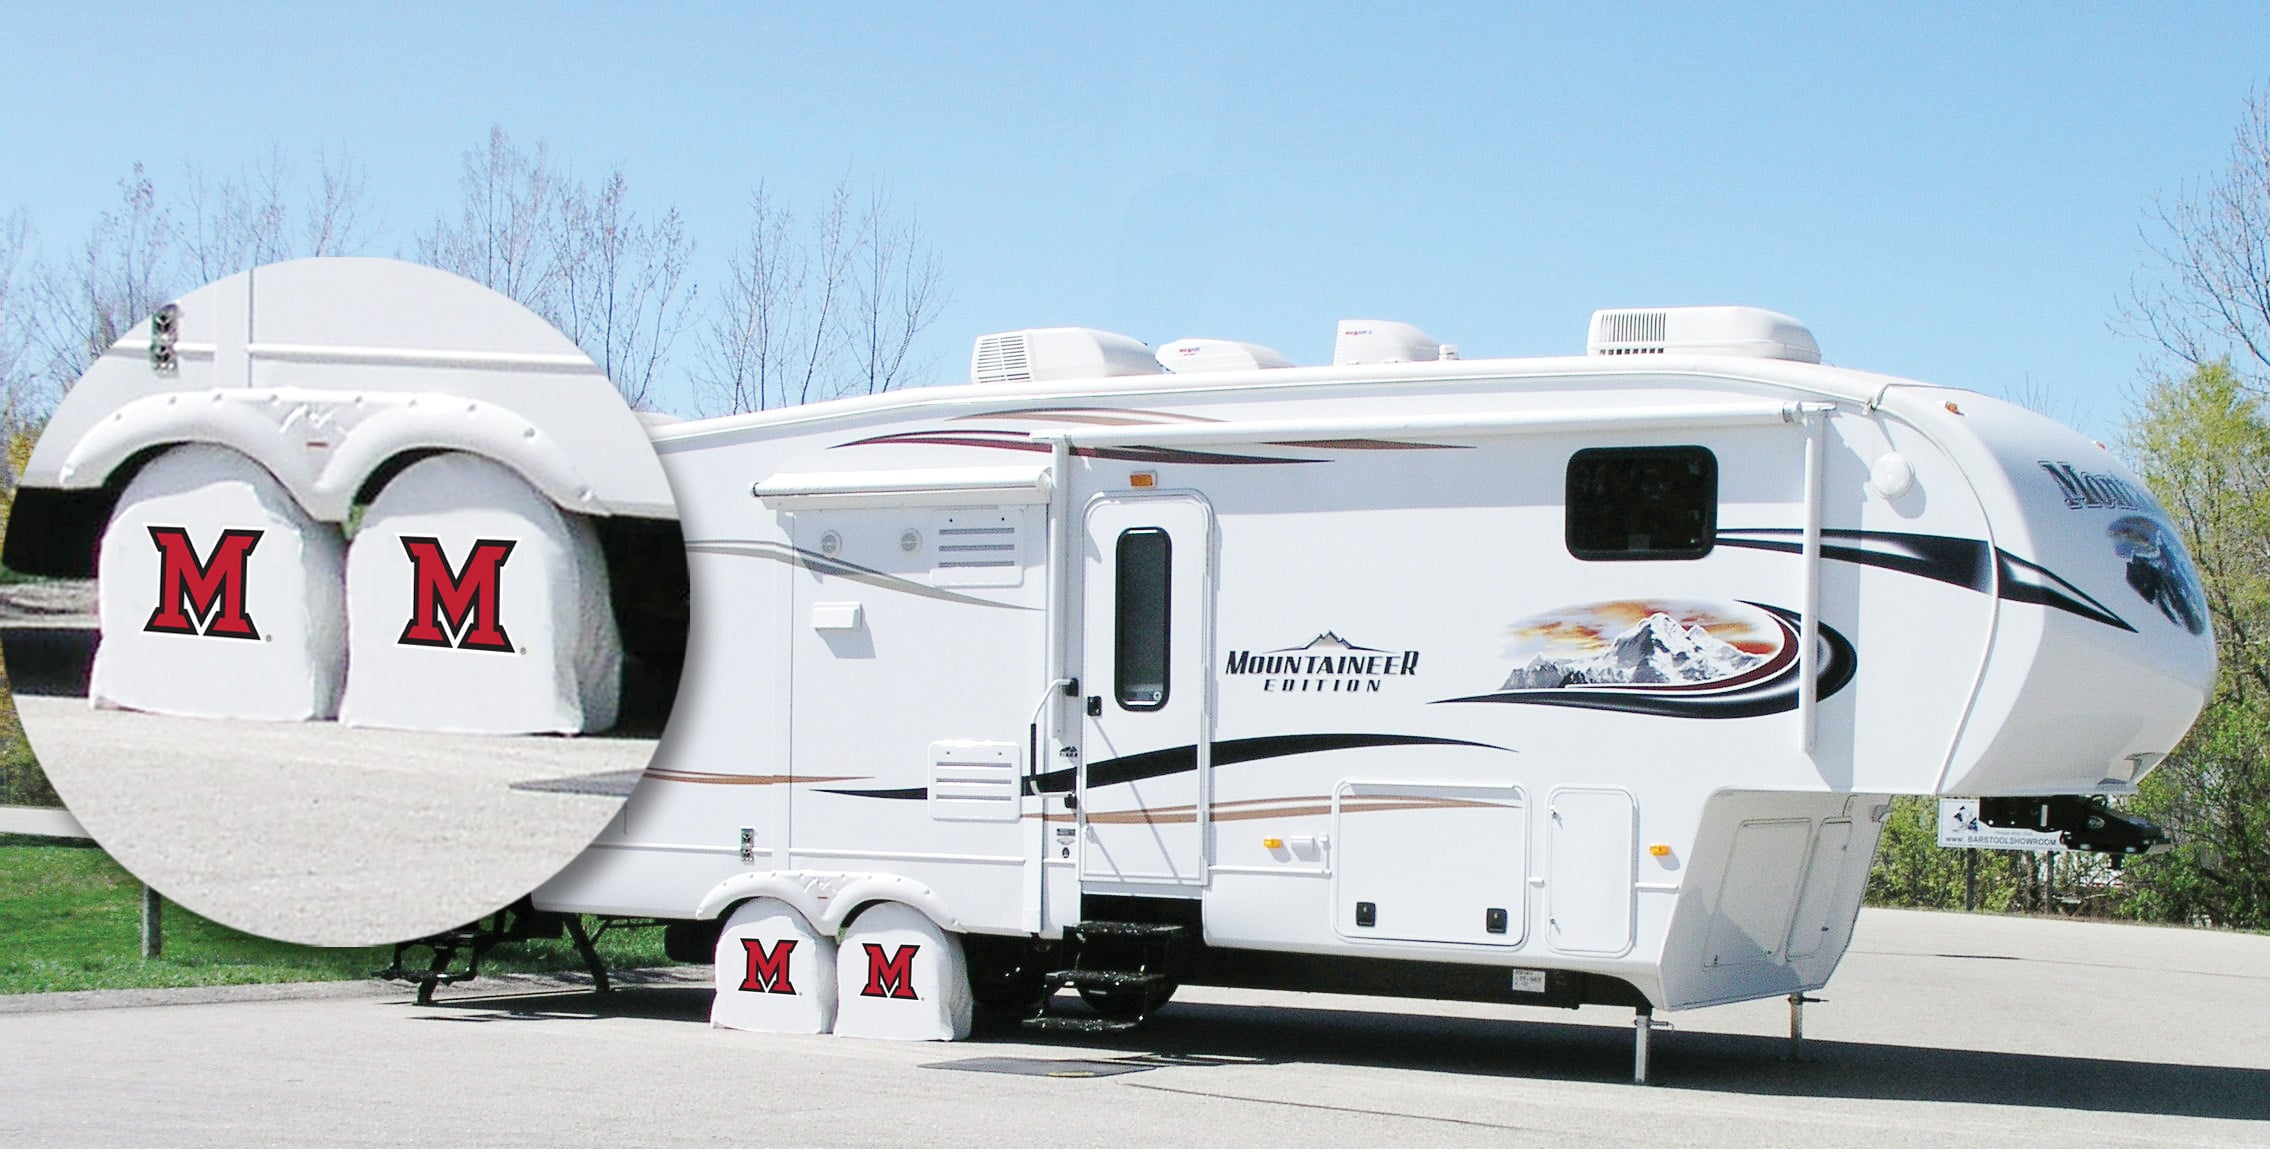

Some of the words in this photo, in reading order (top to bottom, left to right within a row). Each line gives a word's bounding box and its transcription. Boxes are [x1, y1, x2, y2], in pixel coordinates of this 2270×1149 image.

[143, 525, 265, 640] M
[397, 535, 518, 654] M
[1226, 650, 1419, 675] MOUNTAINEER
[1264, 679, 1381, 692] EDITION
[738, 937, 799, 995] M
[860, 942, 921, 1000] M
